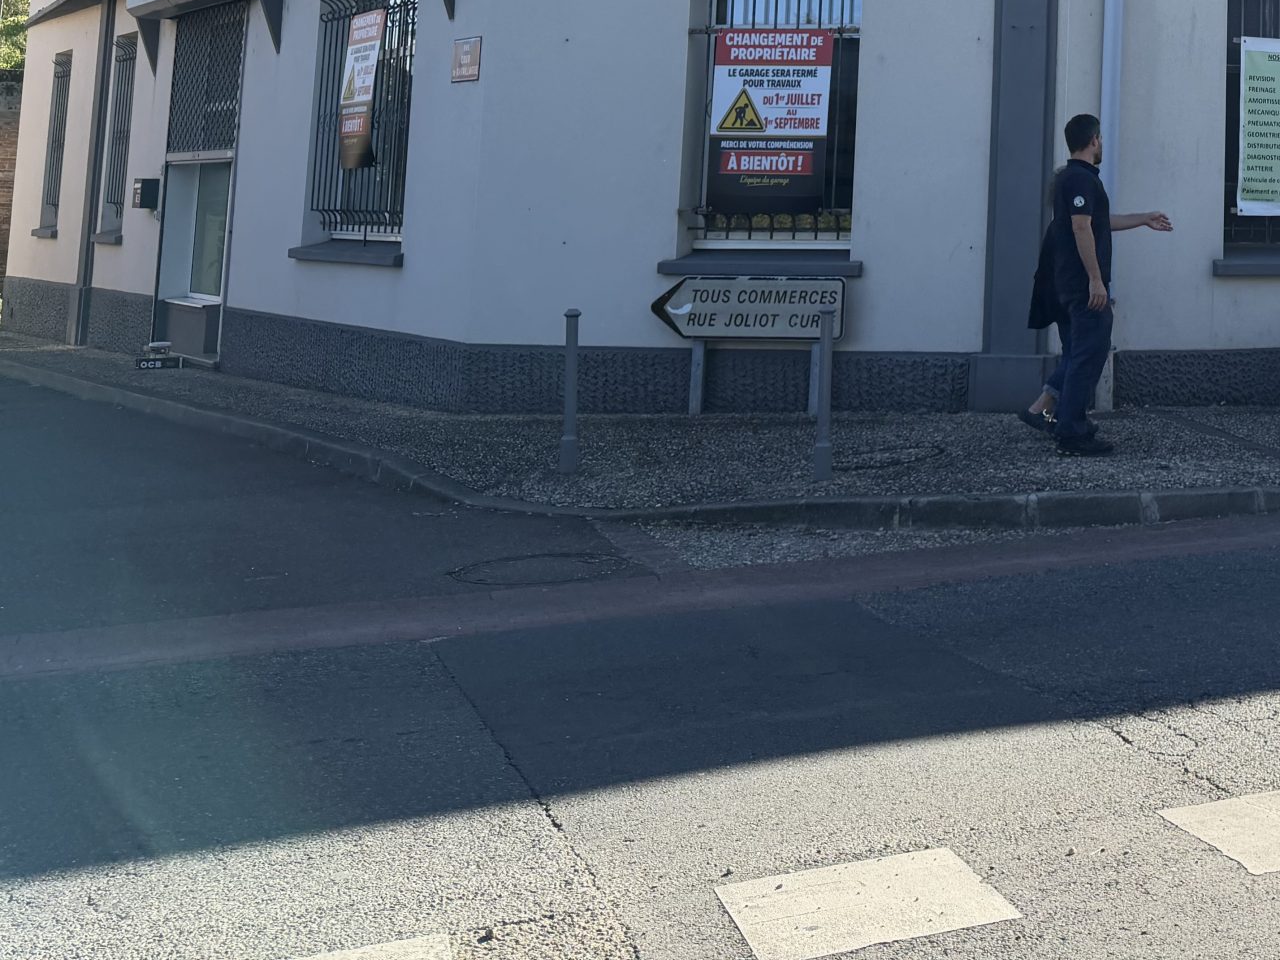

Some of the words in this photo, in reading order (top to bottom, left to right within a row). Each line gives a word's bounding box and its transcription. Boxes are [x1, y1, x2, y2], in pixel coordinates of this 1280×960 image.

[725, 32, 810, 46] CHANGEMENT
[811, 36, 823, 46] DE
[730, 44, 817, 60] PROPRIÉTAIRE
[728, 68, 738, 77] LE
[738, 68, 770, 77] GARAGE
[771, 68, 792, 78] SERA
[792, 66, 818, 78] FERMÉ
[743, 79, 764, 88] POUR
[766, 79, 802, 88] TRAVAUX
[763, 95, 774, 105] DU
[774, 93, 785, 105] 1er
[785, 93, 822, 106] JUILLET
[764, 117, 773, 129] 1er
[774, 117, 821, 129] SEPTEMBRE
[1247, 131, 1280, 139] GEOMETRIE
[720, 140, 739, 149] MERCI
[740, 140, 747, 149] DE
[748, 140, 767, 149] VOTRE
[767, 139, 814, 149] COMPRÉHENSION
[727, 152, 738, 170] À
[740, 152, 796, 171] BIENTÔT
[797, 155, 804, 171] !
[1242, 187, 1270, 195] Paiement
[691, 289, 731, 304] TOUS
[737, 289, 838, 305] COMMERCES
[686, 313, 717, 327] RUE
[724, 313, 780, 328] JOLIOT
[788, 313, 824, 329] CUR
[140, 361, 162, 369] OCB
